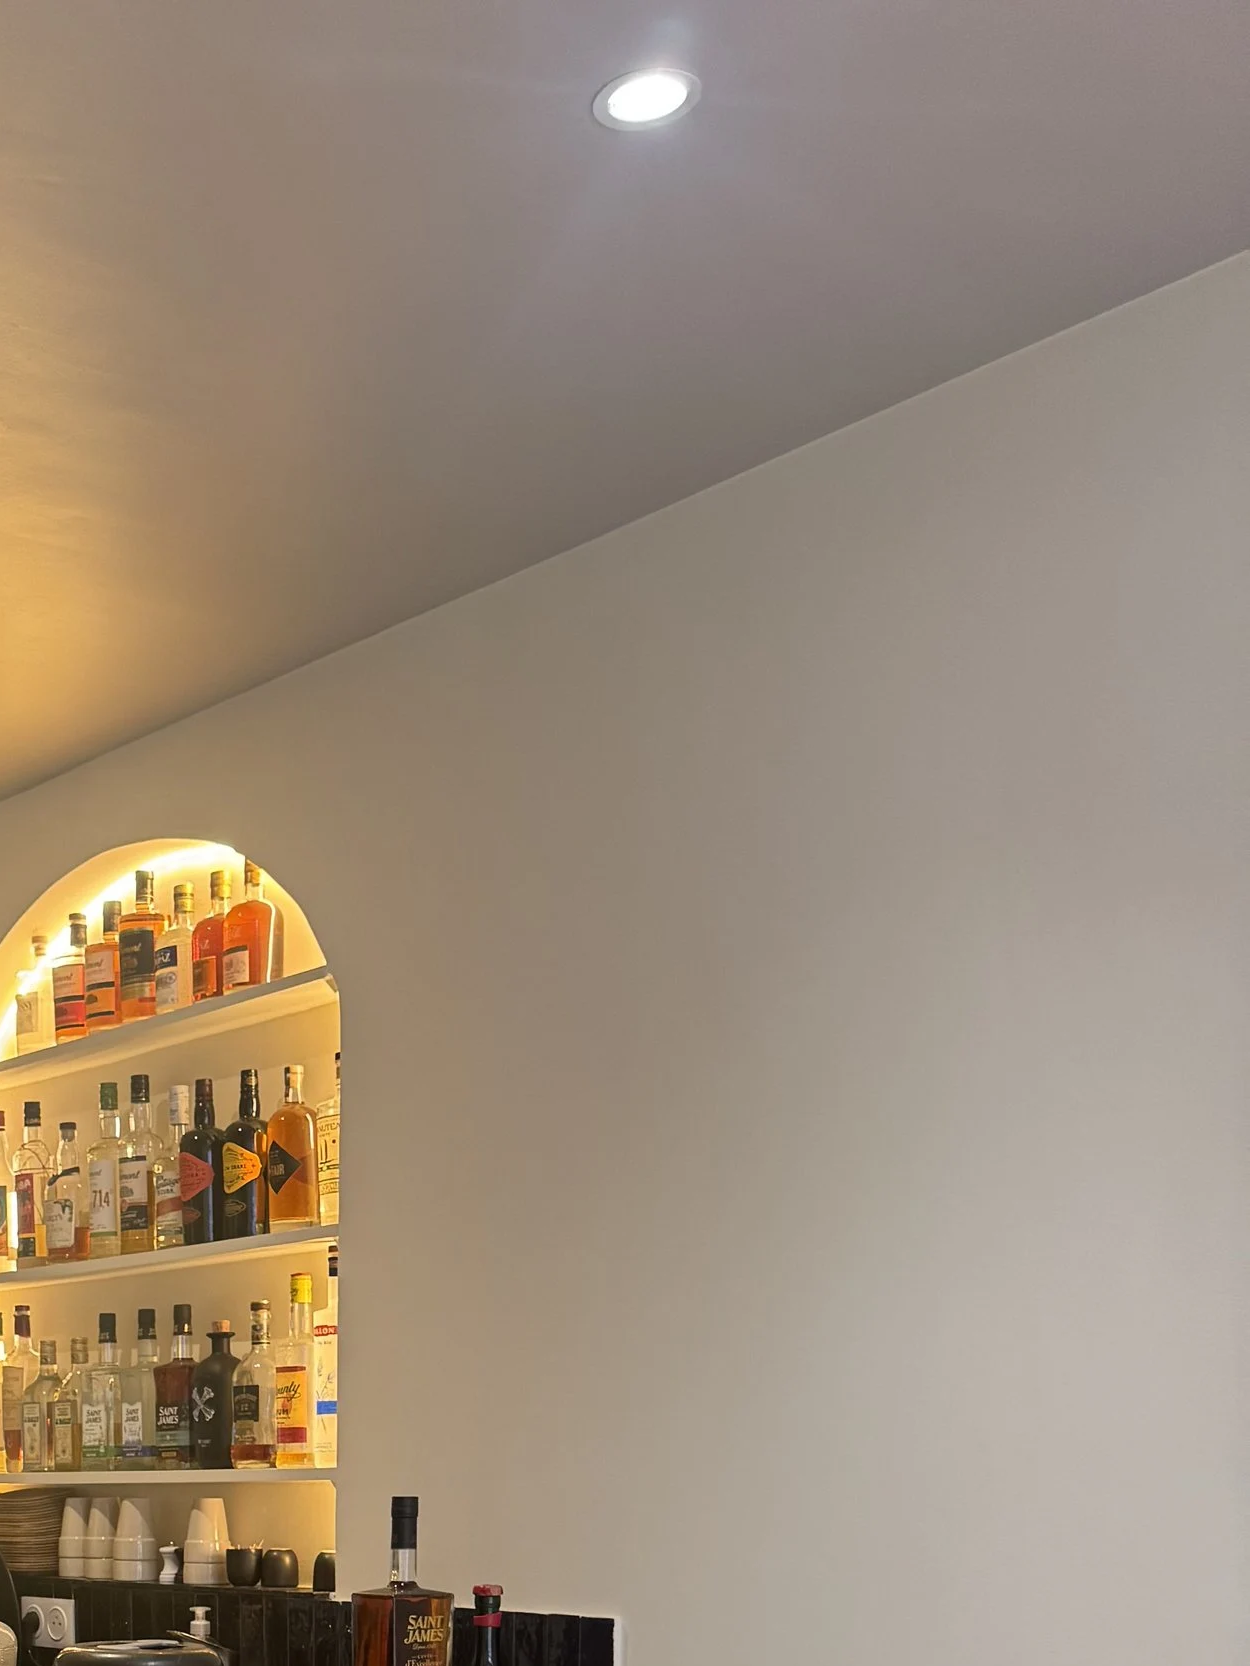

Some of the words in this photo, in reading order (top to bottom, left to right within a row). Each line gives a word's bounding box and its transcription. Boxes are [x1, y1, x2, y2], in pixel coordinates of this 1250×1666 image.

[158, 1406, 179, 1416] SAINT
[157, 1415, 179, 1425] JAMES
[407, 1614, 445, 1630] SAINT
[404, 1628, 444, 1645] JAMES
